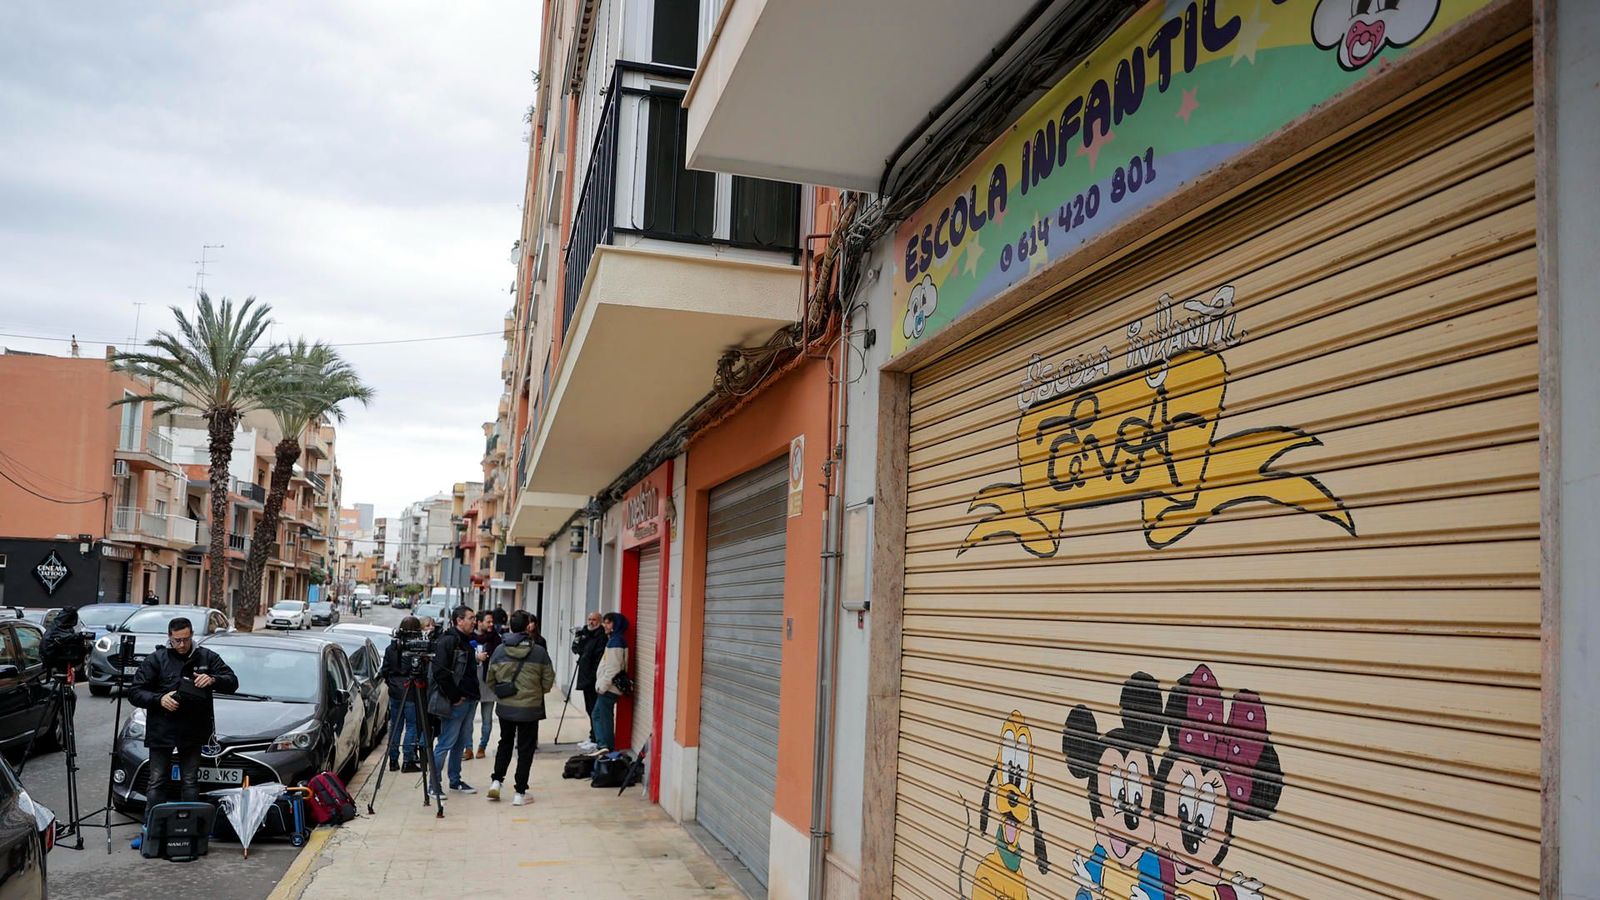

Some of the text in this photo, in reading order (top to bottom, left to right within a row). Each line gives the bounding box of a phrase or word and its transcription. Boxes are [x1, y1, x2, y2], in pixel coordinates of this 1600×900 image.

[905, 0, 1242, 283] ESCOLA INFANTIL
[1017, 146, 1157, 262] 614 420 801
[215, 769, 239, 782] JKS
